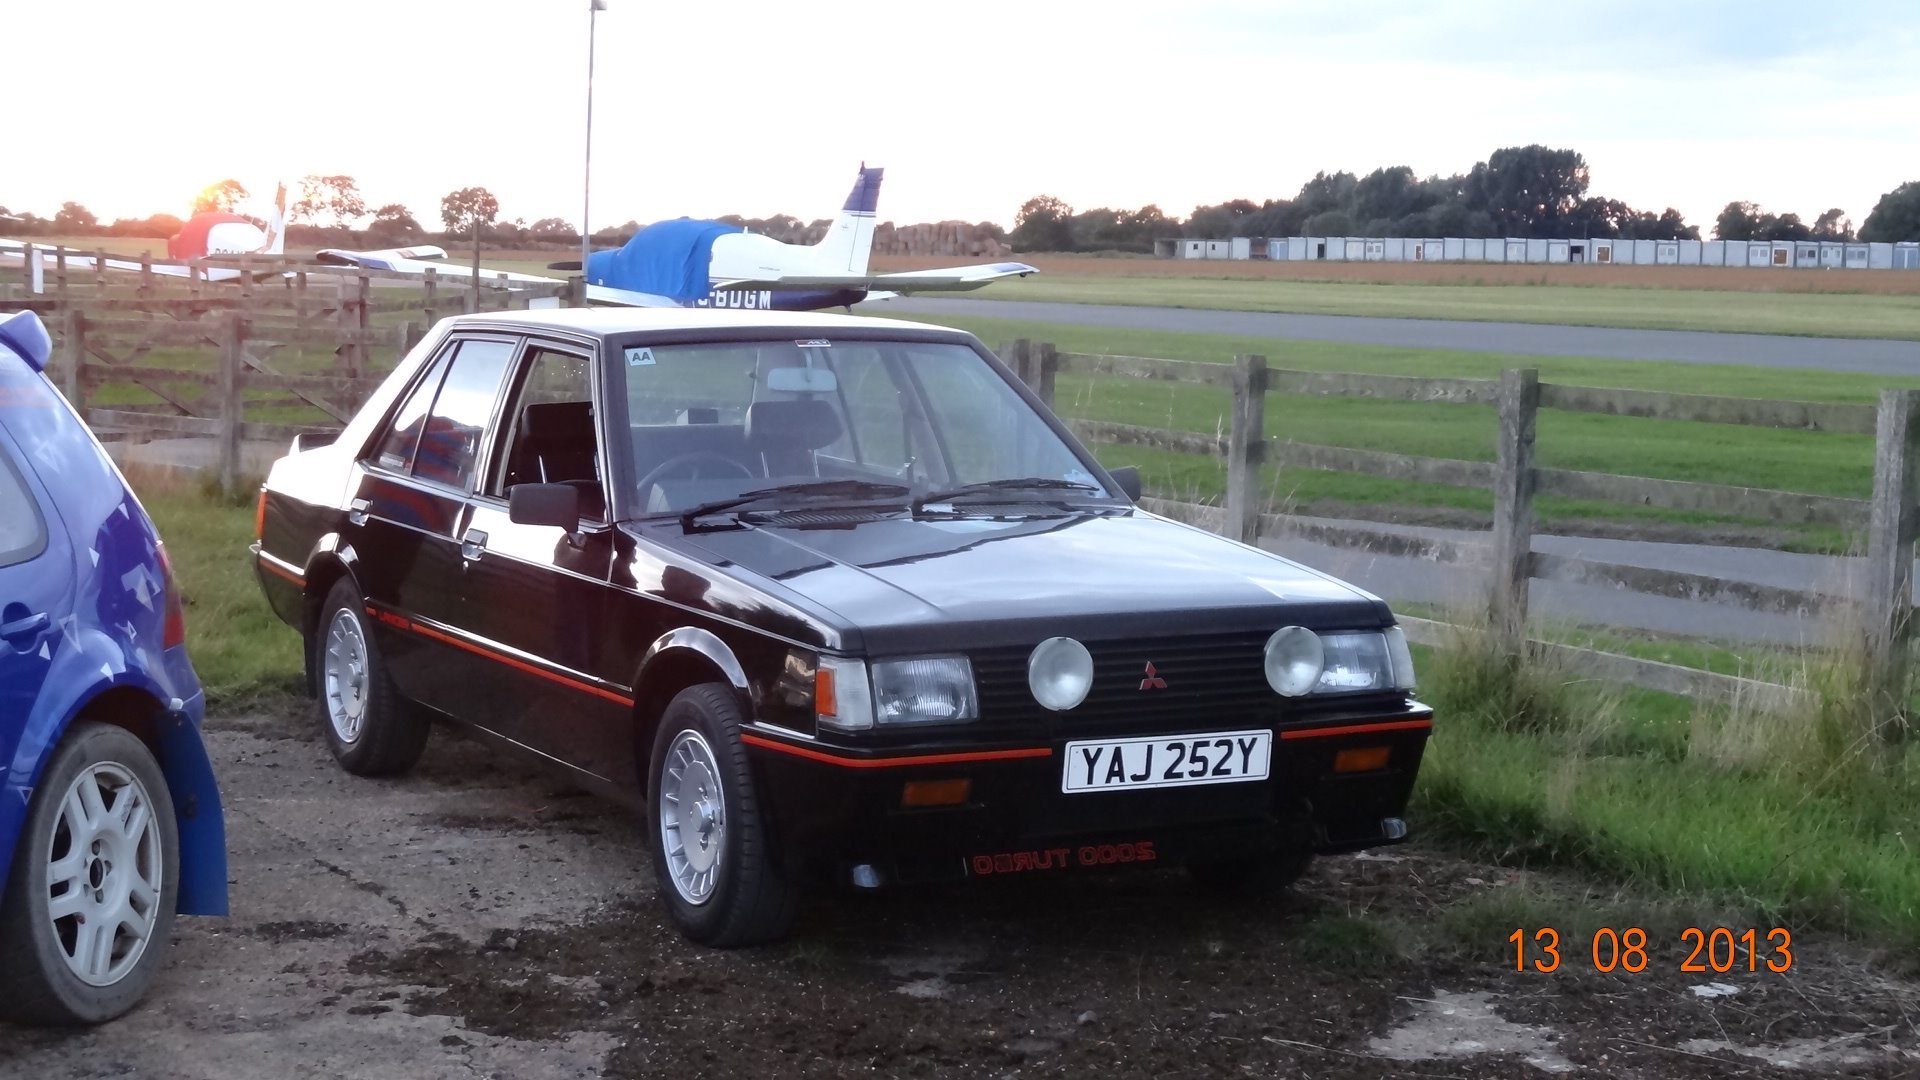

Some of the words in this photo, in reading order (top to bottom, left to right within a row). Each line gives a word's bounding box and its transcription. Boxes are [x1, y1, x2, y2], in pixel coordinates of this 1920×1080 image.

[632, 352, 651, 362] AA
[1082, 744, 1154, 785] YAJ
[1163, 737, 1258, 780] 252Y
